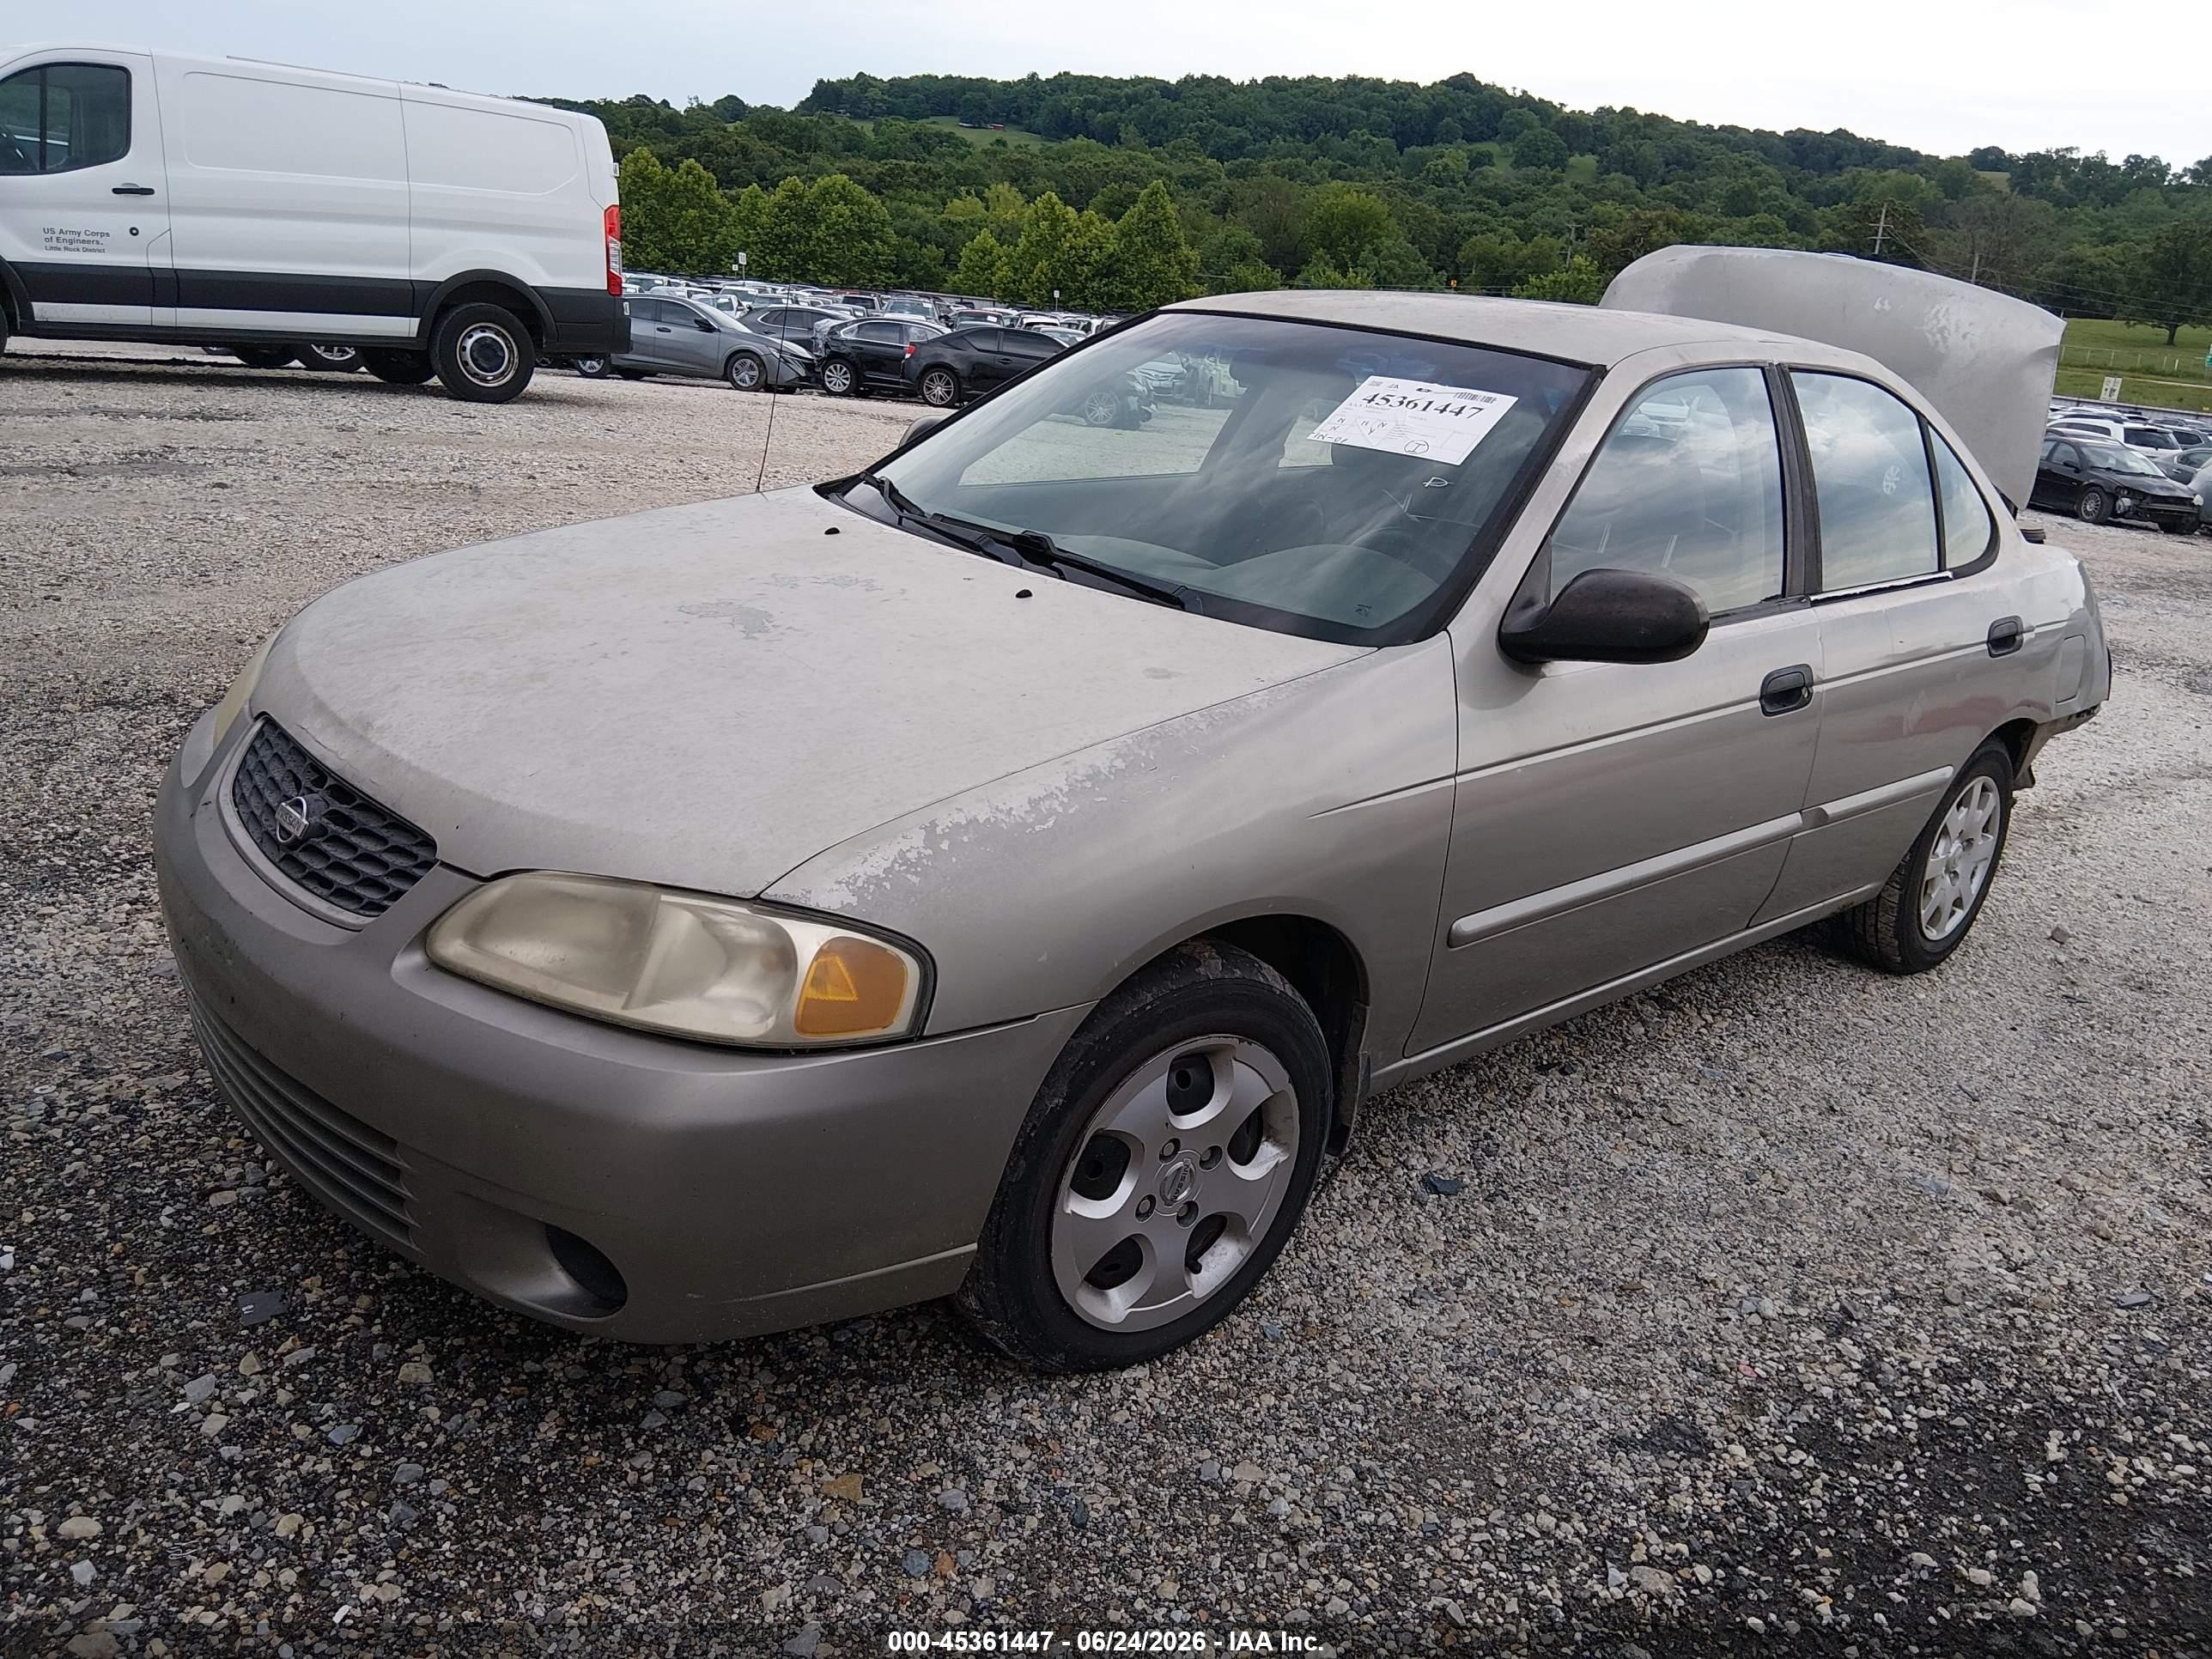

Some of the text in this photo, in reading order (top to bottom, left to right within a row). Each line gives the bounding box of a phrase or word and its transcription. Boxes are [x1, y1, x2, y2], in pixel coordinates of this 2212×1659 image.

[58, 228, 82, 237] Army
[84, 229, 111, 239] Corps
[1362, 392, 1484, 418] 45361447
